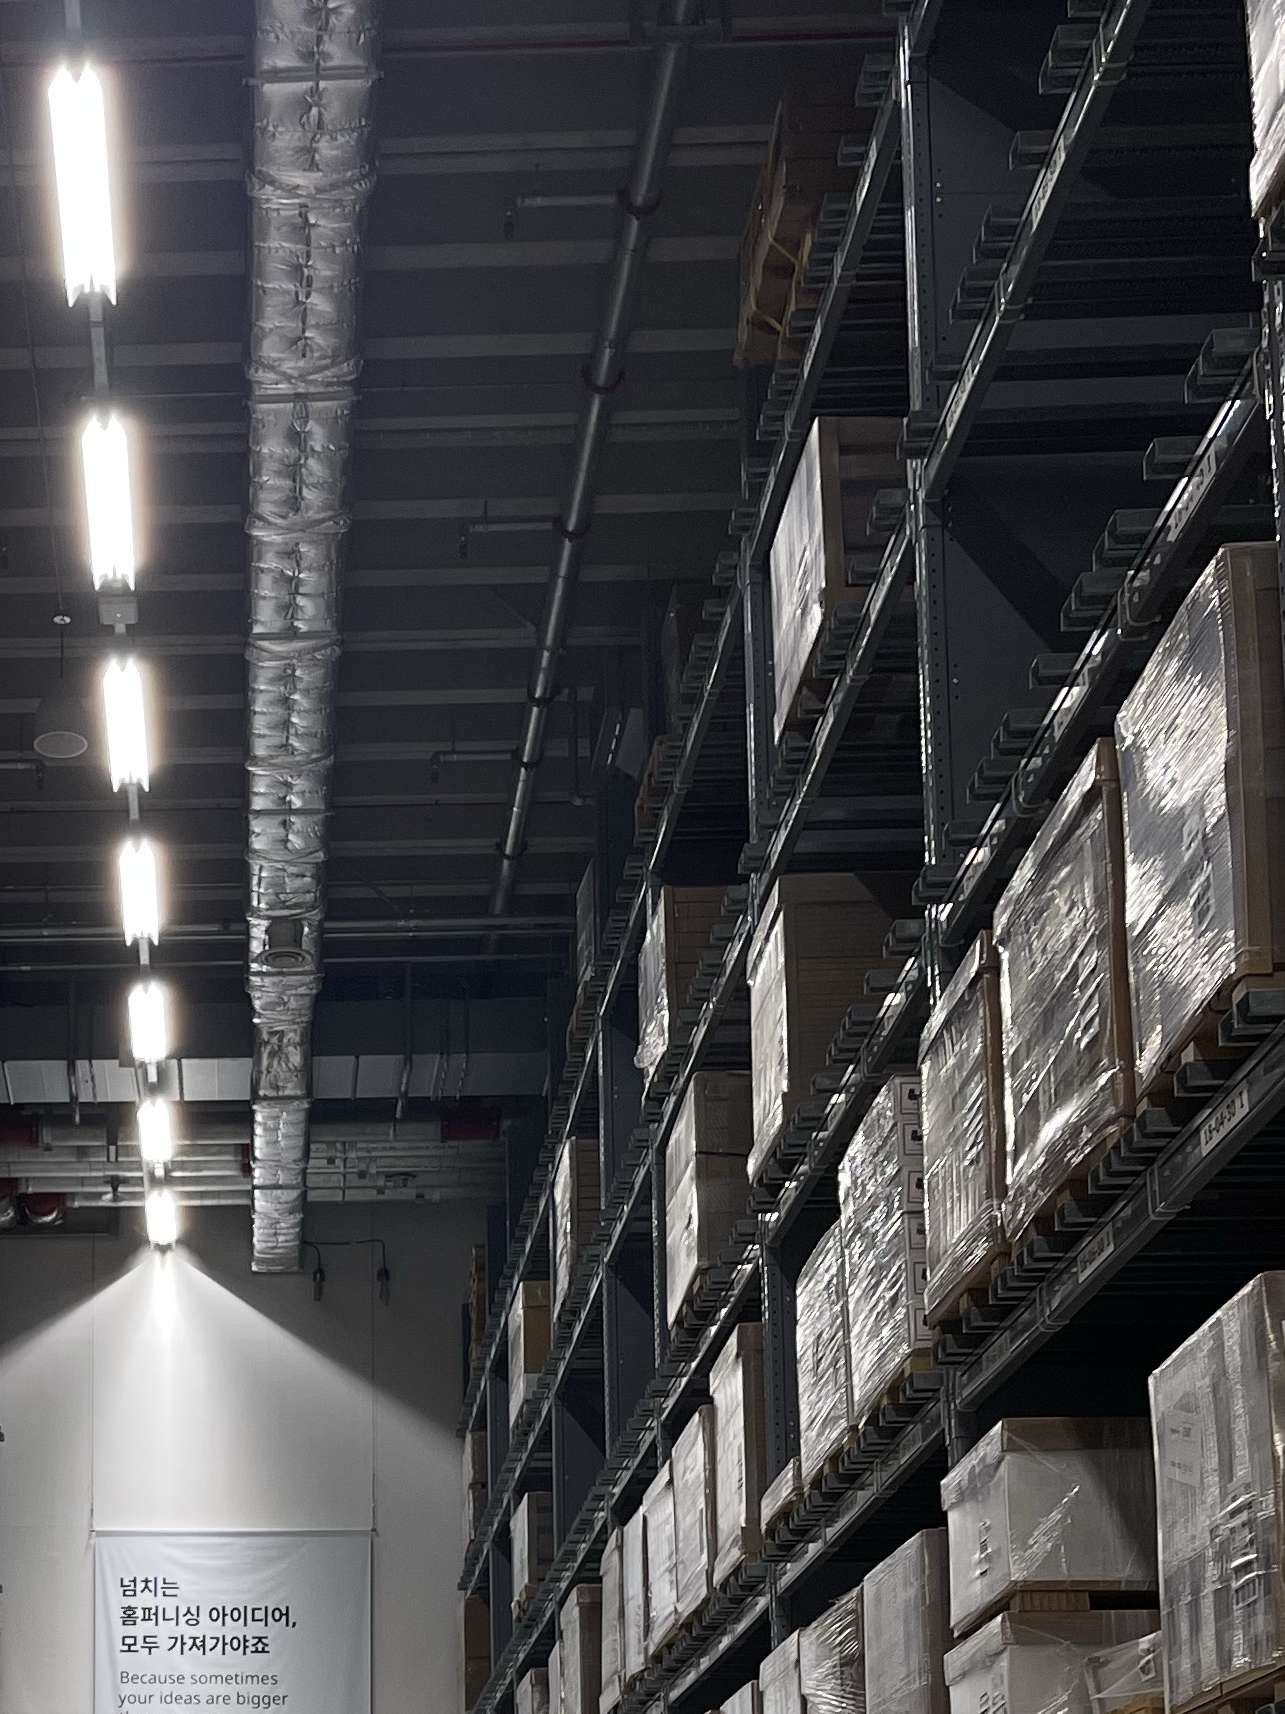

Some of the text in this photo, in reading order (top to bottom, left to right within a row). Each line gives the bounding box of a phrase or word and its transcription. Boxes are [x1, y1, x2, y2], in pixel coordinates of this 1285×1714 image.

[119, 1576, 180, 1598] 넘치는
[119, 1605, 297, 1629] 홈퍼니싱 아이디어,
[119, 1633, 271, 1656] 모두 가져가야죠
[119, 1670, 279, 1686] Because sometimes
[117, 1690, 289, 1710] your ideas are bigger
